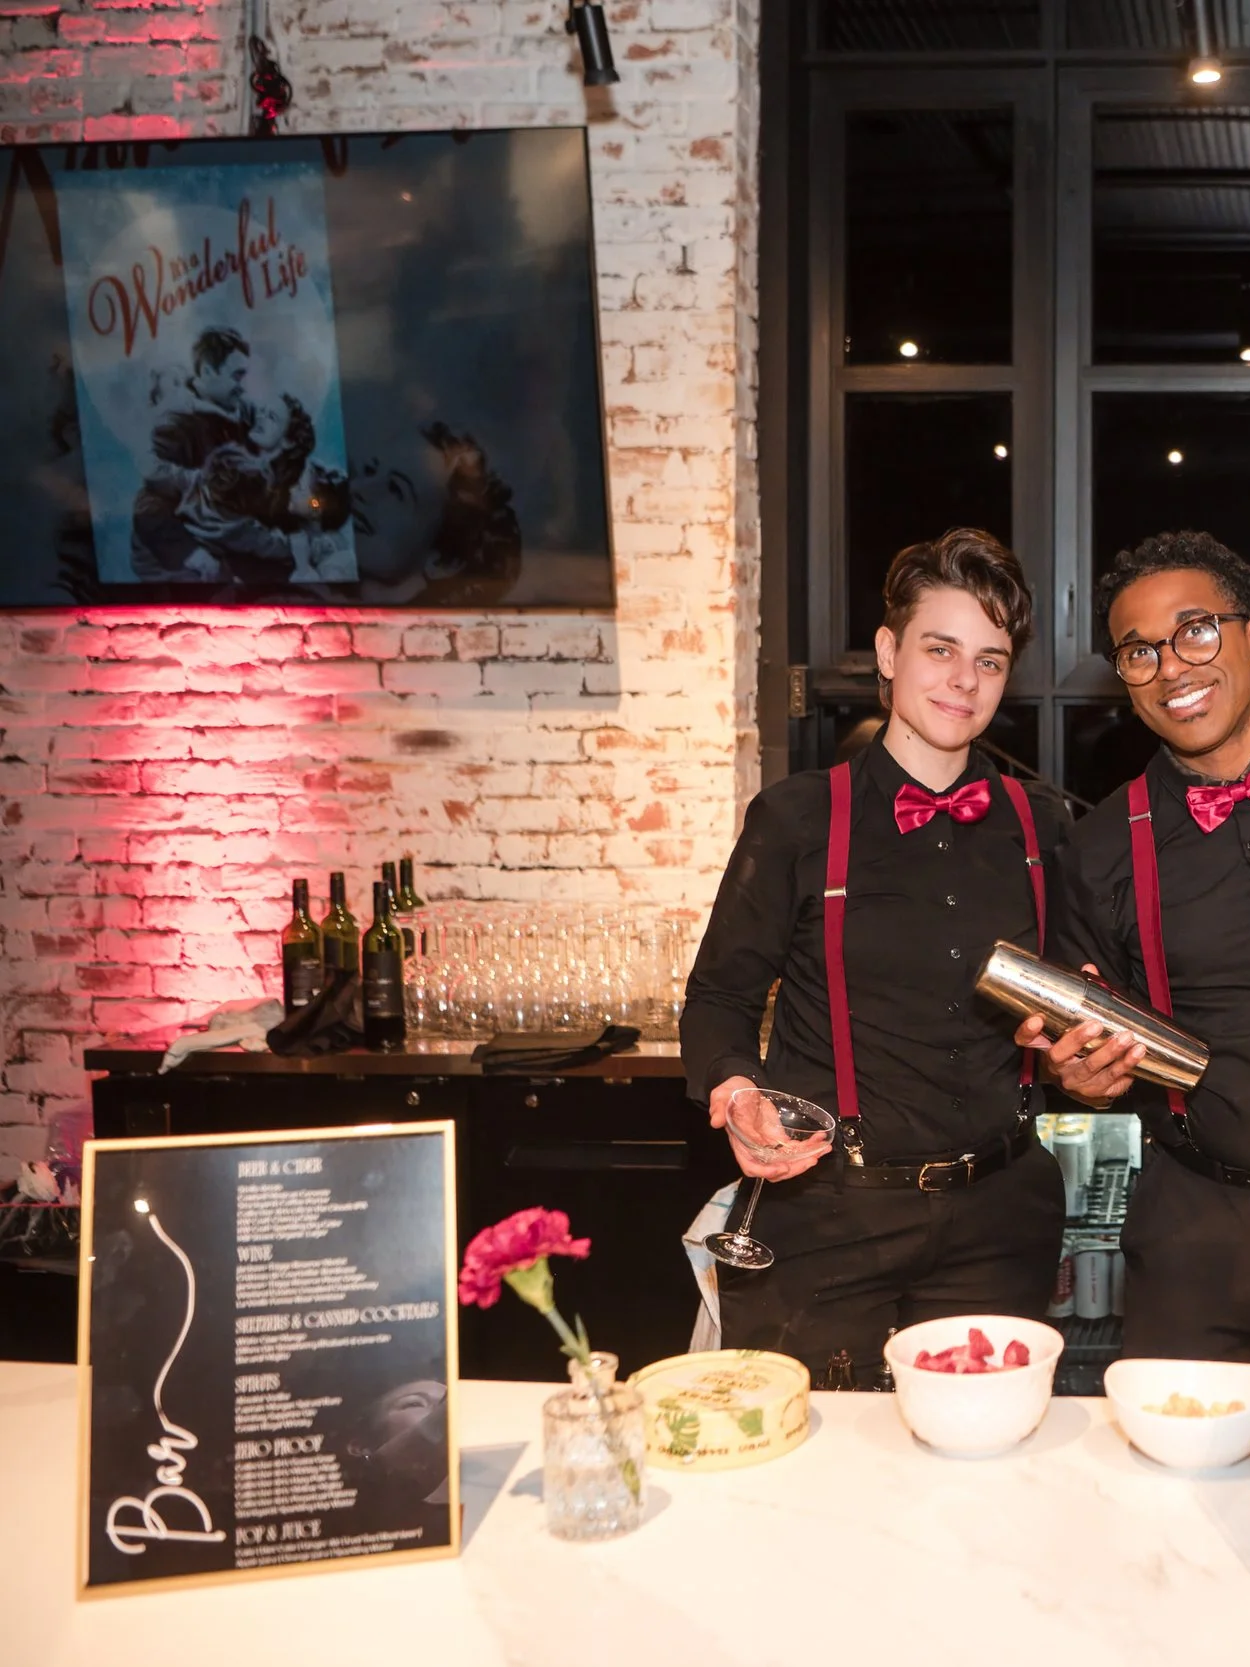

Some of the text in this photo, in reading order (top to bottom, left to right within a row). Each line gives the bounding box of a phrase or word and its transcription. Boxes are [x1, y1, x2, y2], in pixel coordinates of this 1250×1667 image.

[88, 195, 281, 358] Wonderful
[260, 243, 308, 298] Life
[238, 1161, 268, 1178] BEER
[282, 1157, 323, 1175] CIDER
[237, 1244, 274, 1262] WINE
[360, 1302, 439, 1324] COCKTAILS
[234, 1435, 324, 1460] ZERO PROOF
